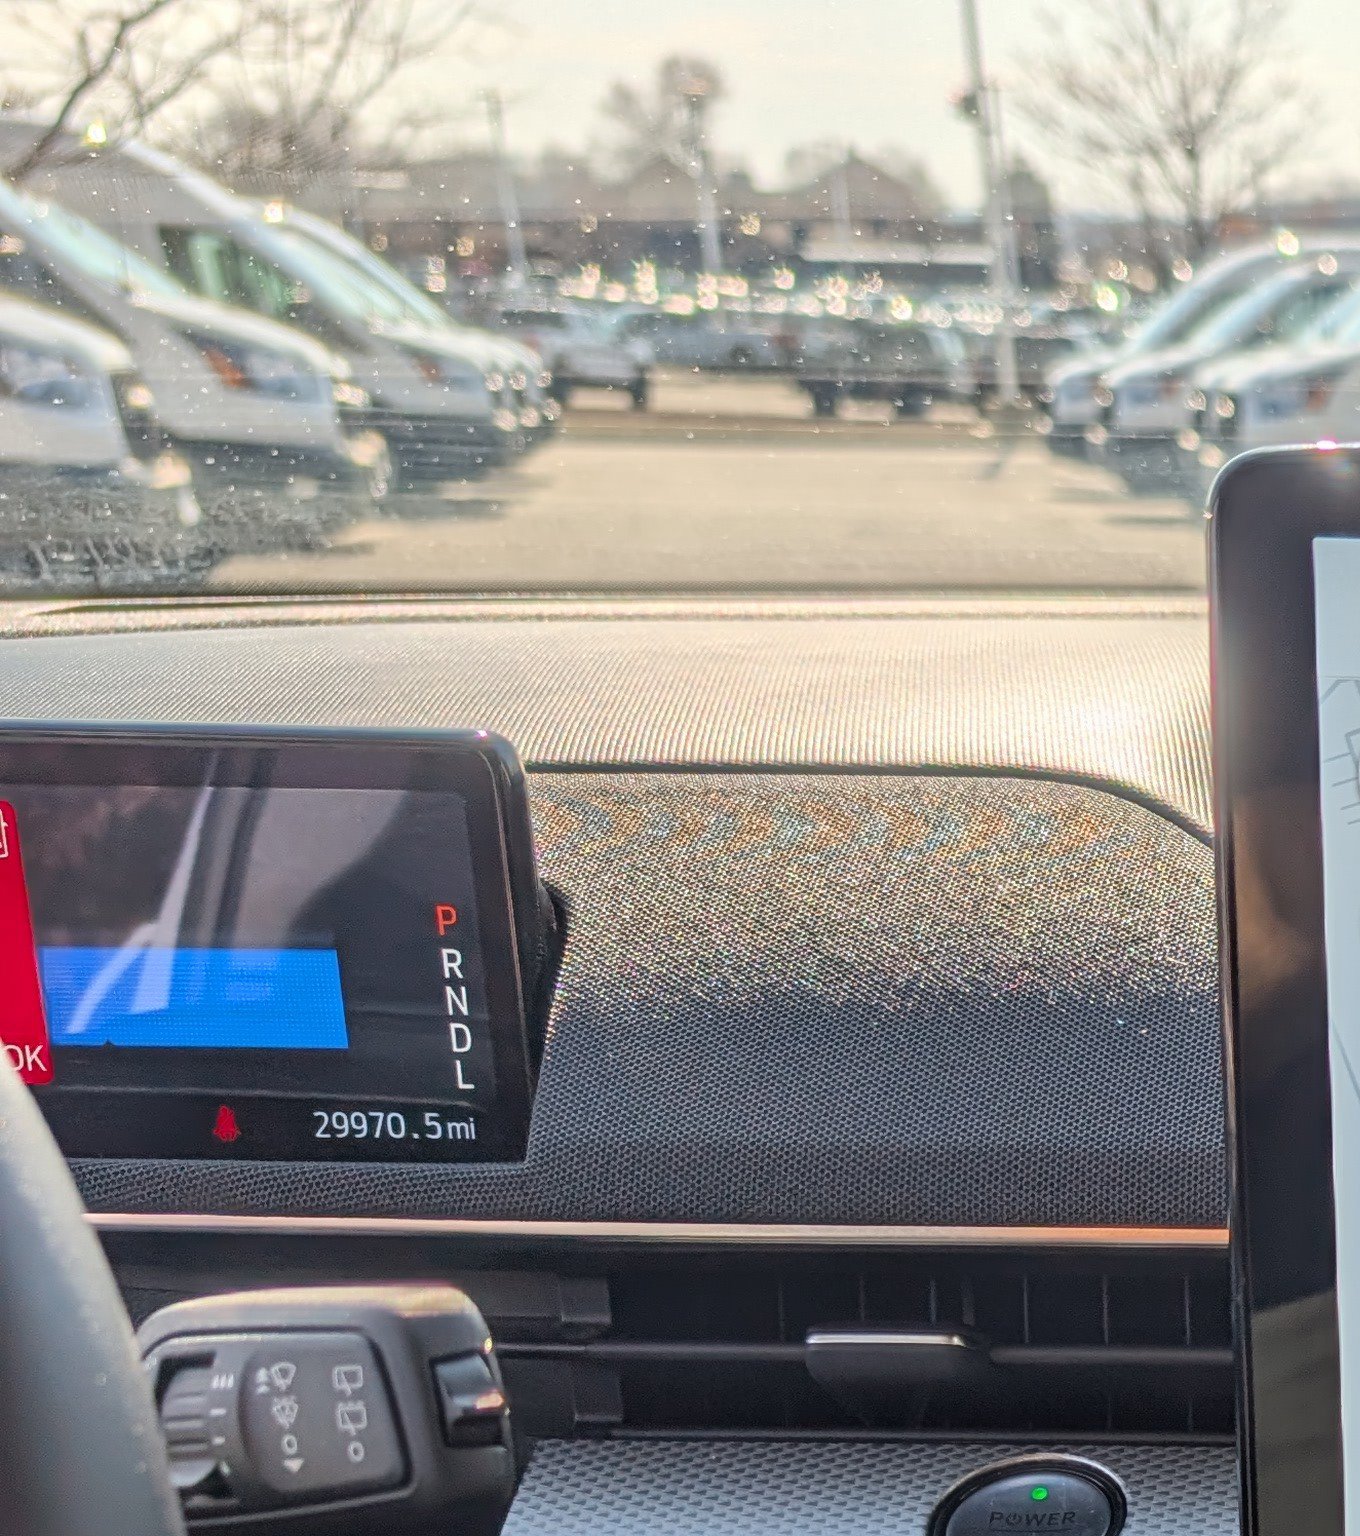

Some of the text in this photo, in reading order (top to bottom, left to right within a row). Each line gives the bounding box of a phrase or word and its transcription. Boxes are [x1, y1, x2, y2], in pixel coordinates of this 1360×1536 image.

[436, 905, 457, 936] P
[441, 948, 464, 979] R
[445, 985, 469, 1016] N
[449, 1022, 472, 1053] D
[3, 1044, 48, 1072] OK
[455, 1059, 475, 1090] L
[446, 1116, 477, 1140] mi
[989, 1511, 1076, 1526] POWER
